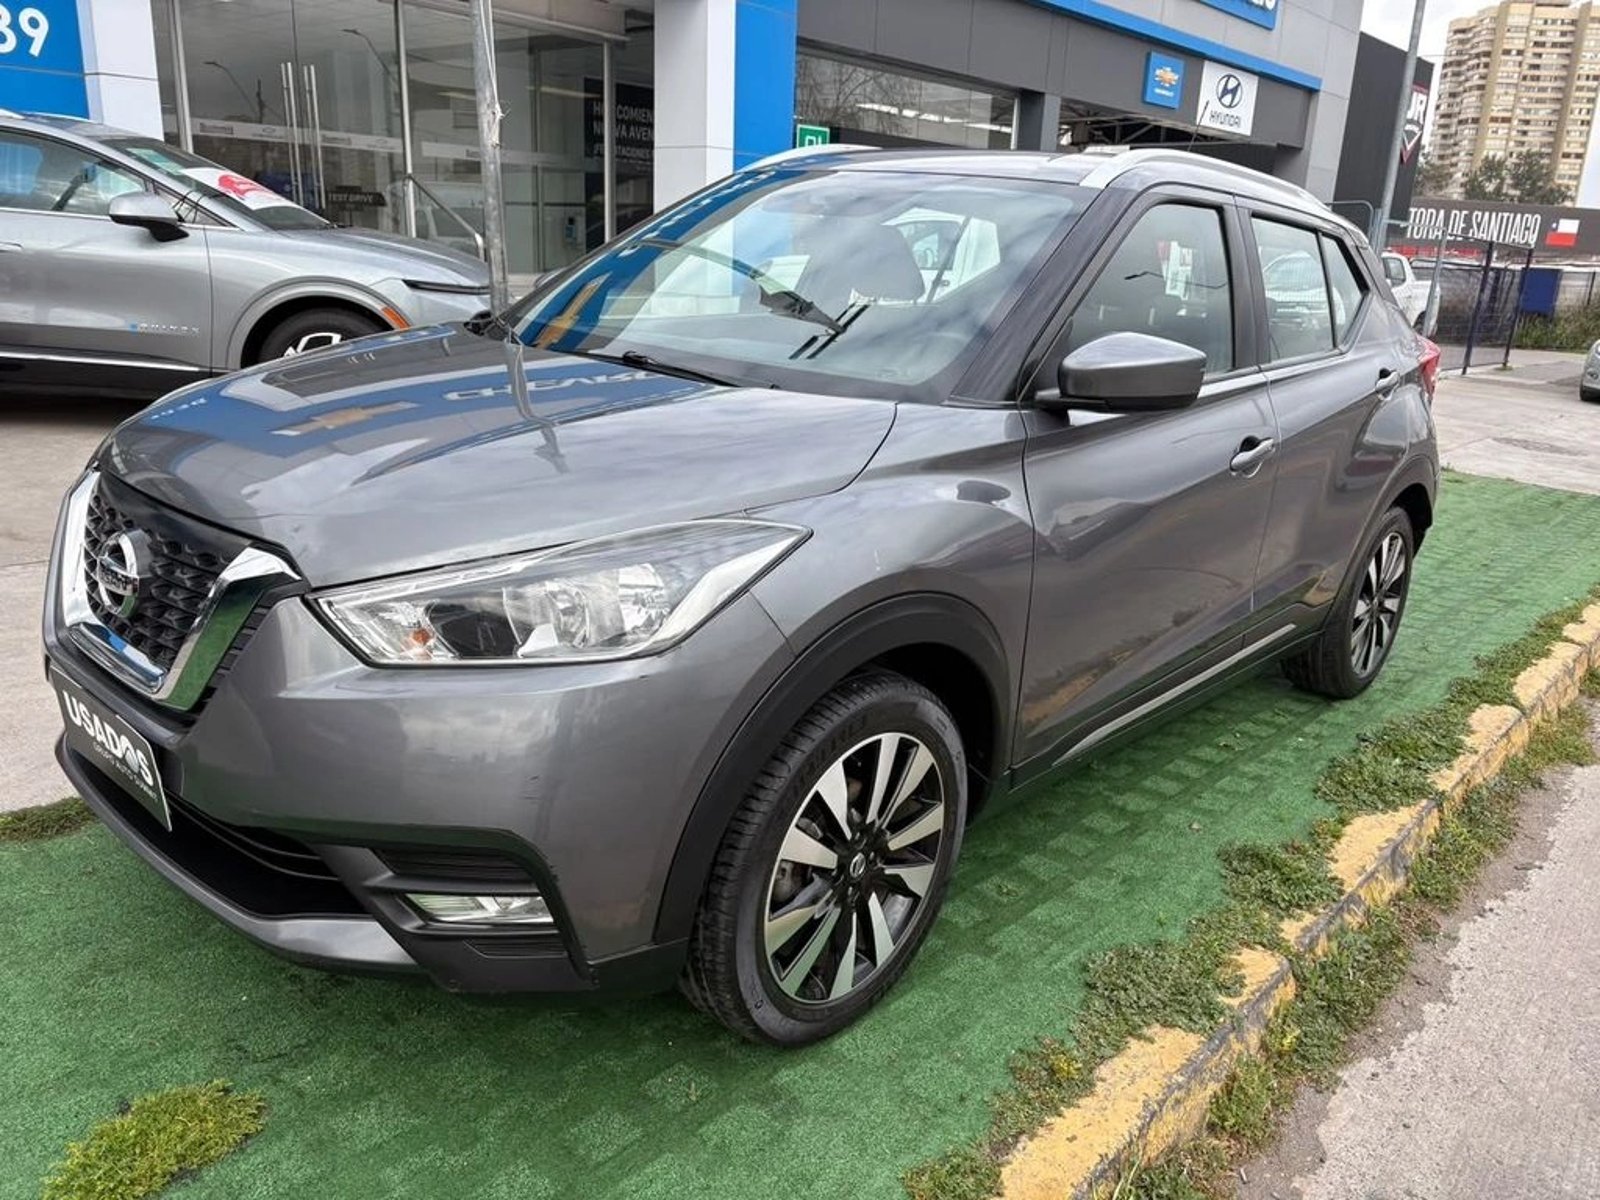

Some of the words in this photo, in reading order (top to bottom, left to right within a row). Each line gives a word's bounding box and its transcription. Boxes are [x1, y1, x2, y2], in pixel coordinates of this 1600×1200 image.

[1447, 210, 1469, 241] DE
[1469, 210, 1541, 248] SANTIAGO
[63, 689, 154, 787] USADOS
